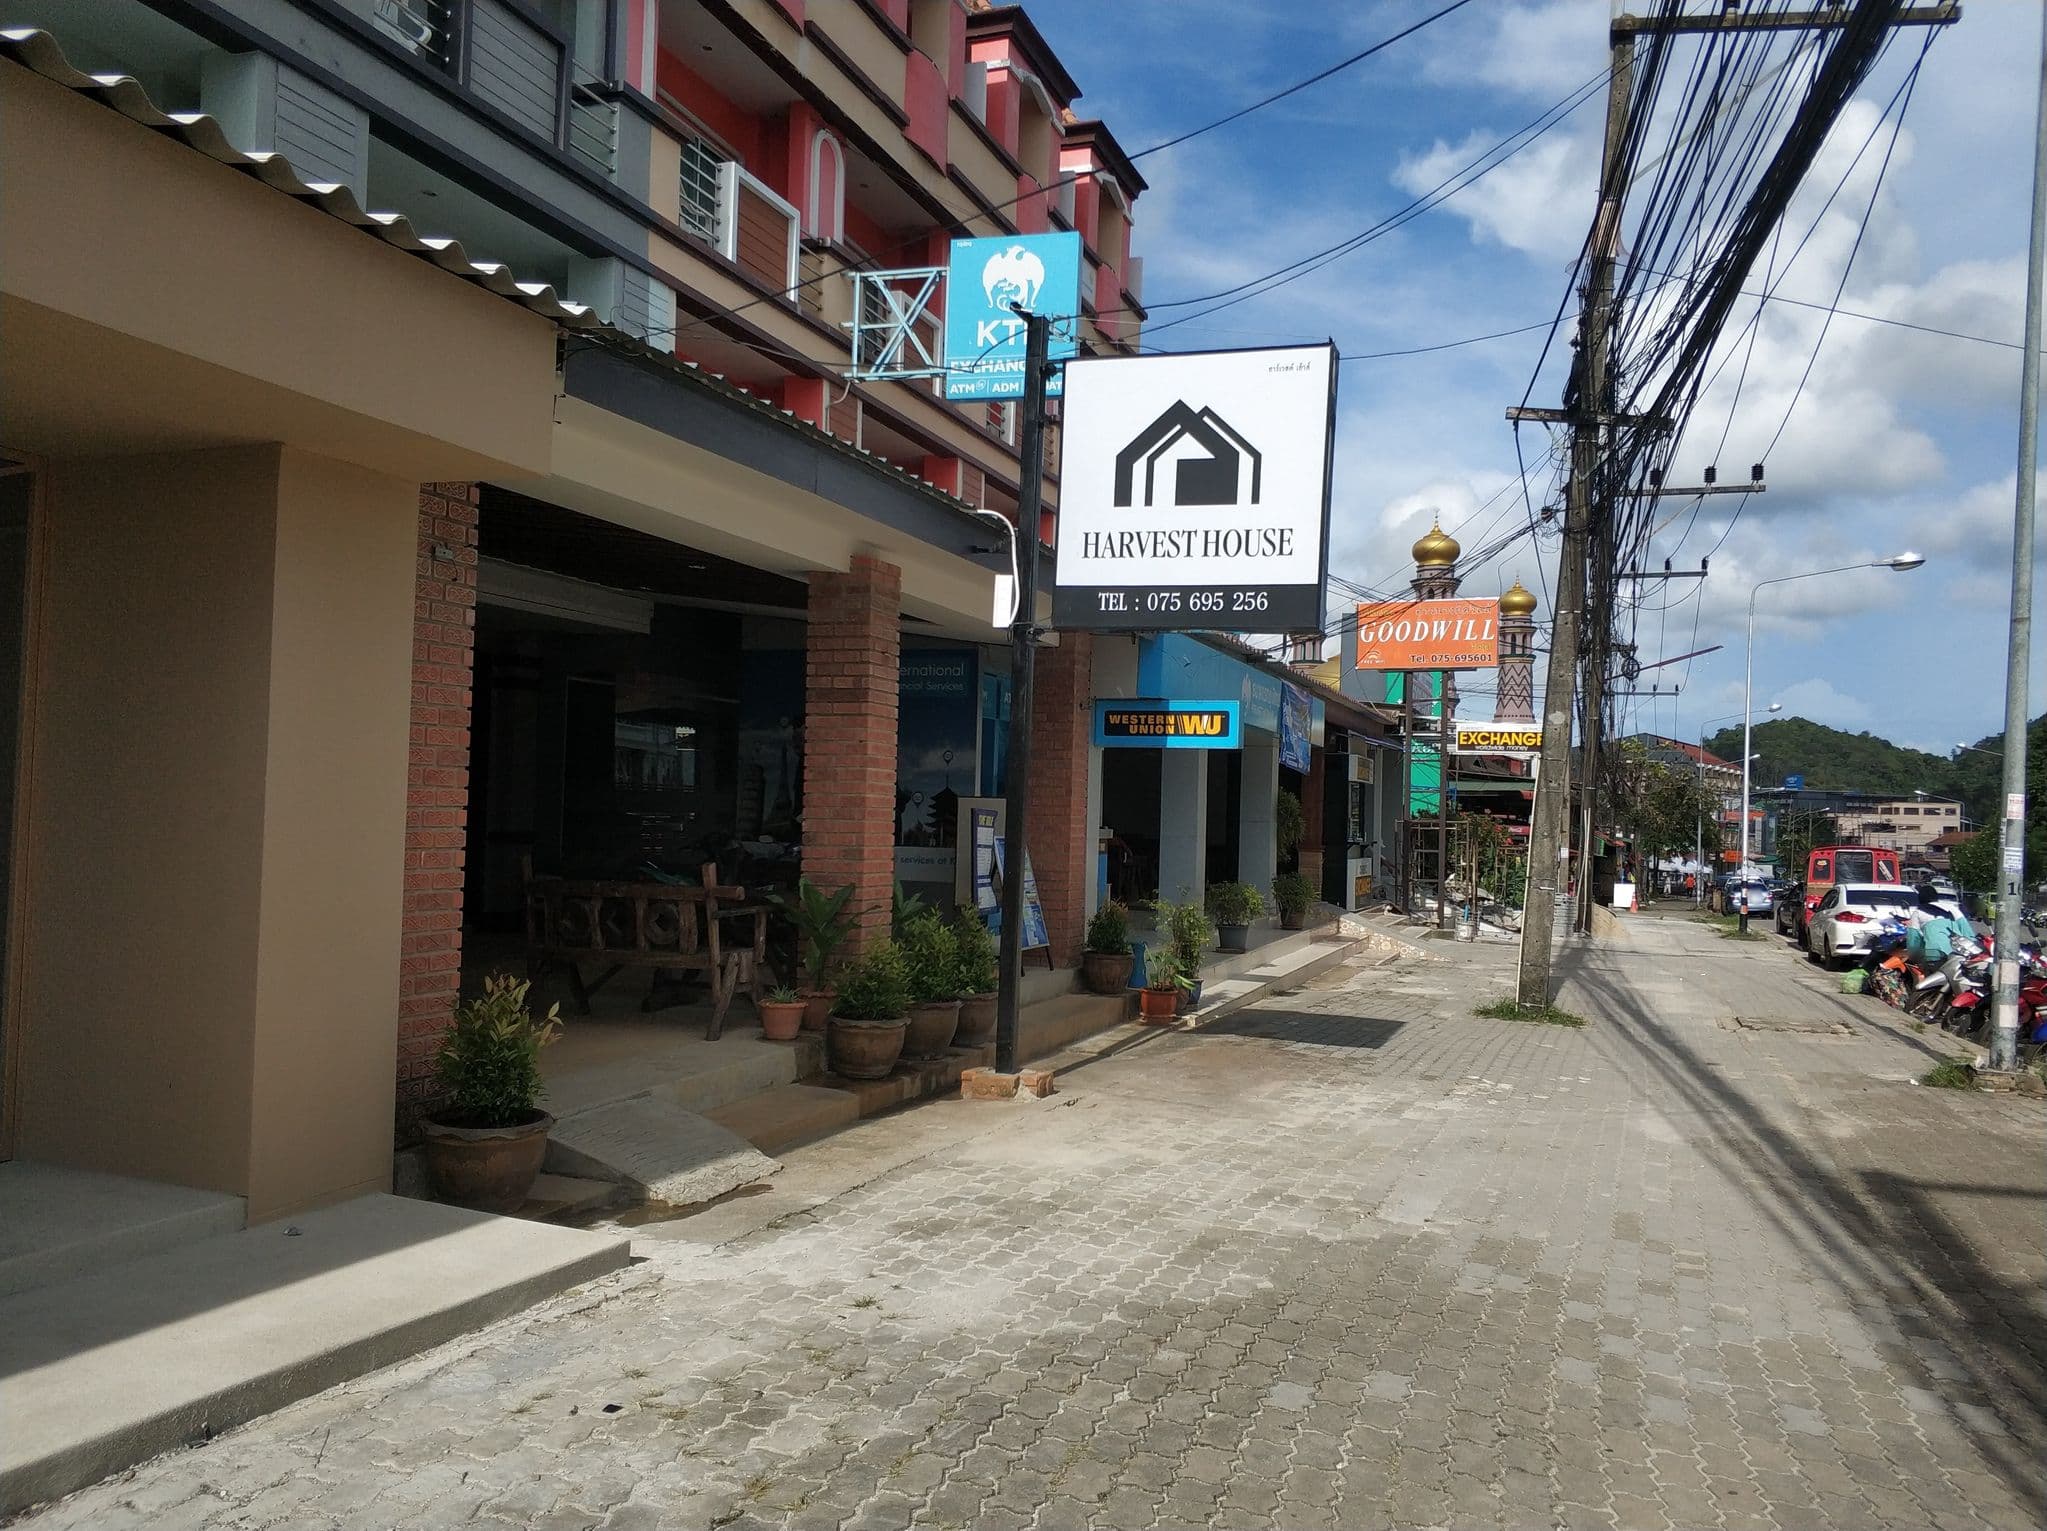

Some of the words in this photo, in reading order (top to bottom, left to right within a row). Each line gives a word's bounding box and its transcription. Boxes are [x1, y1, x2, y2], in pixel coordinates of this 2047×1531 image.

[977, 319, 1028, 348] KT
[950, 383, 974, 394] ATM
[992, 381, 1019, 393] ADM
[1082, 529, 1197, 559] HARVEST
[1203, 528, 1294, 557] HOUSE
[1098, 592, 1128, 611] TEL
[1147, 592, 1181, 612] 075
[1189, 592, 1224, 612] 695
[1232, 592, 1268, 611] 256
[1360, 619, 1495, 644] GOODWILL
[1431, 653, 1493, 664] 075-695601
[1109, 714, 1175, 725] WESTERN
[1129, 724, 1175, 735] UNION
